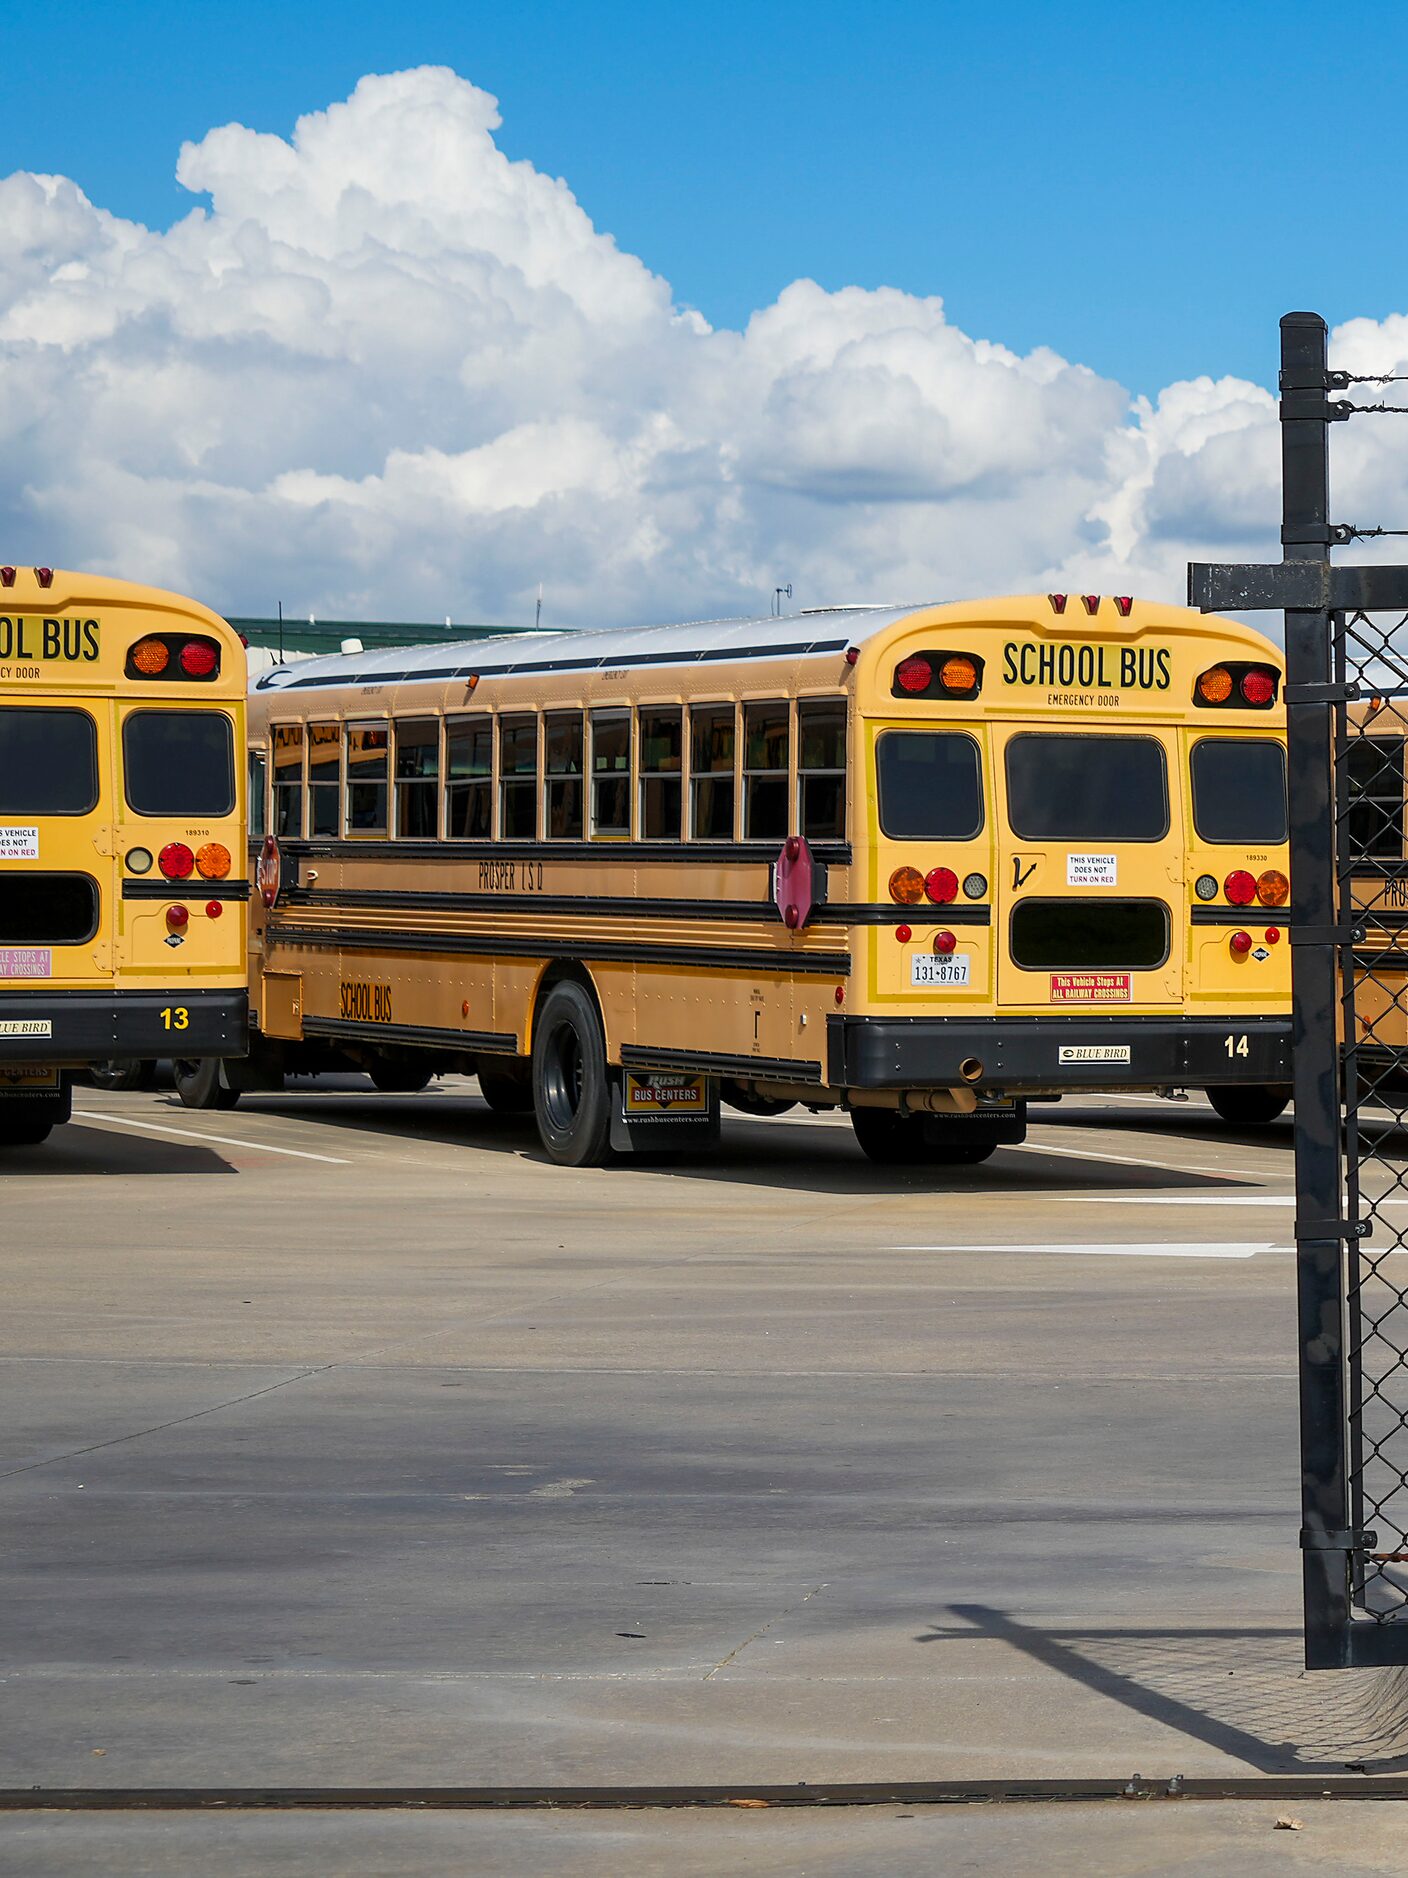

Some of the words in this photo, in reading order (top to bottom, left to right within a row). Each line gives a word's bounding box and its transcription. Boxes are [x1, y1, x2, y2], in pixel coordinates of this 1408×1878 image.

[43, 618, 99, 661] BUS
[1002, 642, 1112, 688] SCHOOL
[1120, 647, 1171, 690] BUS
[16, 667, 40, 679] DOOR
[1047, 693, 1095, 706] EMERGENCY
[1097, 695, 1120, 707] DOOR
[4, 829, 37, 837] VEHICLE
[12, 839, 28, 847] NOT
[1070, 856, 1086, 864] THIS
[1087, 856, 1115, 864] VEHICLE
[478, 861, 515, 890] PROSPER
[1074, 866, 1092, 874] DOES
[1093, 866, 1107, 874] NOT
[13, 951, 36, 963] STOPS
[39, 951, 49, 963] AT
[10, 963, 46, 976] CROSSINGS
[1057, 977, 1071, 987] This
[1072, 976, 1095, 987] Vehicle
[1096, 976, 1115, 988] Stops
[1116, 976, 1124, 987] At
[1052, 988, 1064, 999] ALL
[1065, 988, 1093, 999] RAILWAY
[1093, 988, 1128, 999] CROSSINGS
[340, 981, 373, 1020] SCHOOL
[374, 984, 392, 1022] BUS
[159, 1007, 190, 1031] 13
[21, 1023, 48, 1033] BIRD
[1224, 1034, 1249, 1058] 14
[1076, 1048, 1102, 1058] BLUE
[1103, 1048, 1127, 1059] BIRD
[634, 1089, 653, 1101] BUS
[654, 1088, 697, 1101] CENTERS
